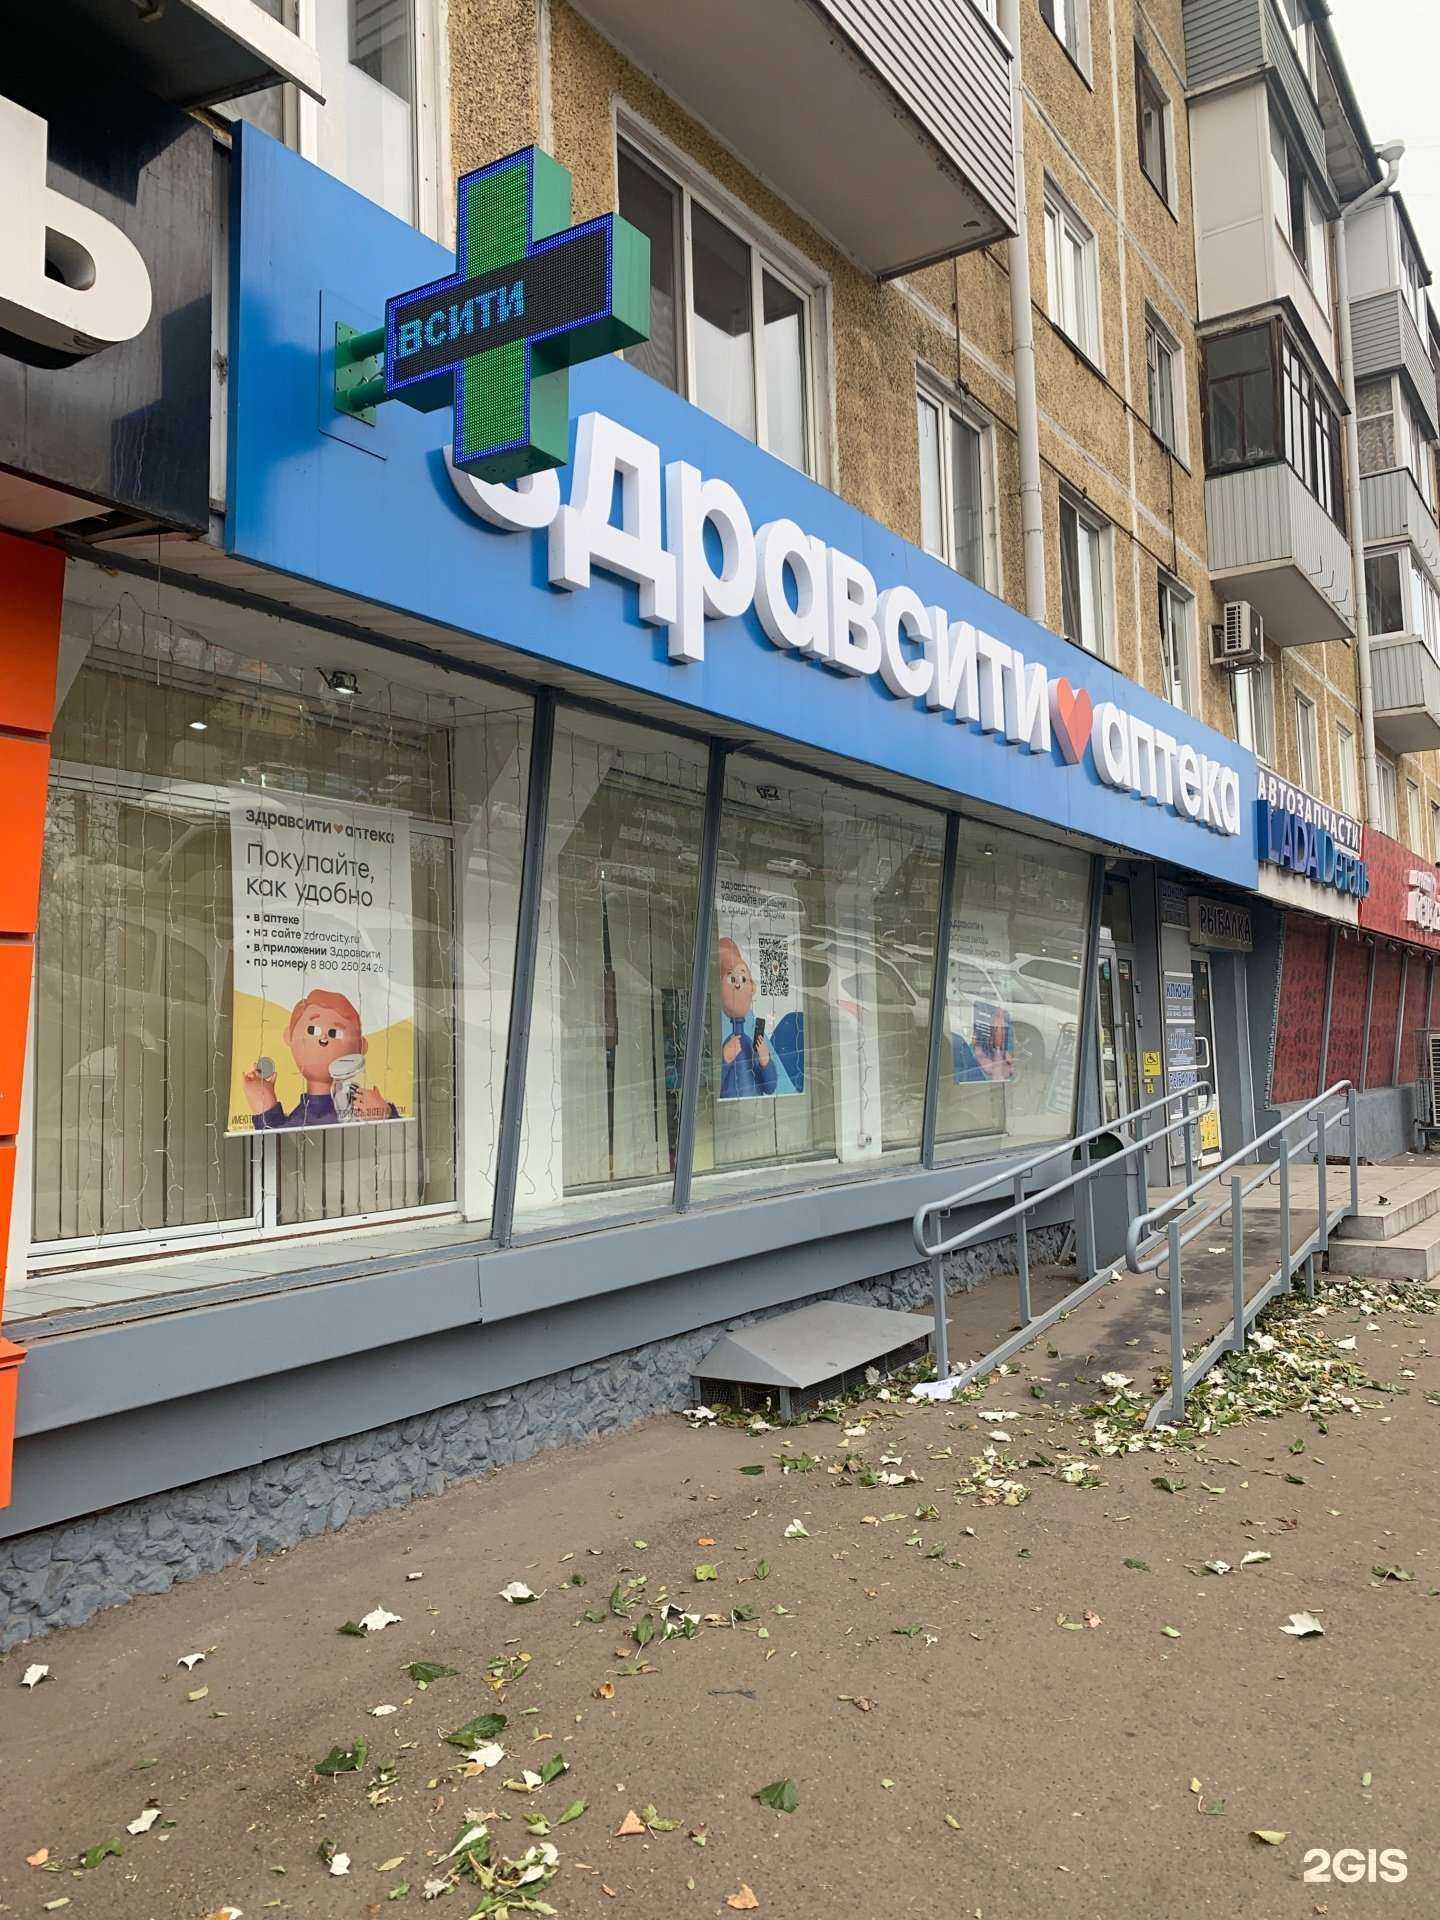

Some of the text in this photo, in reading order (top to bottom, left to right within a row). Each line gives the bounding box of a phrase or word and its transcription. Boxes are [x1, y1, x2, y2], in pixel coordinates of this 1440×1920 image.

[1092, 702, 1241, 836] аптека
[1257, 769, 1360, 851] АВТОЗАПЧАСТИ
[245, 809, 394, 844] здравсити аптека
[1257, 799, 1321, 881] LADA
[247, 843, 374, 884] Покупайте,
[246, 877, 373, 906] как удобно
[253, 914, 300, 924] в аптеке
[1199, 904, 1252, 944] РЫБАЛКА
[253, 930, 361, 945] на сайте zdravcity.ru
[253, 943, 381, 959] в приложении Здравсити
[253, 959, 267, 968] по
[271, 959, 308, 971] номеру
[310, 960, 316, 969] 8
[319, 960, 338, 970] 800
[341, 962, 358, 971] 250
[361, 963, 372, 972] 24
[1166, 983, 1191, 1000] КЛЮЧИ
